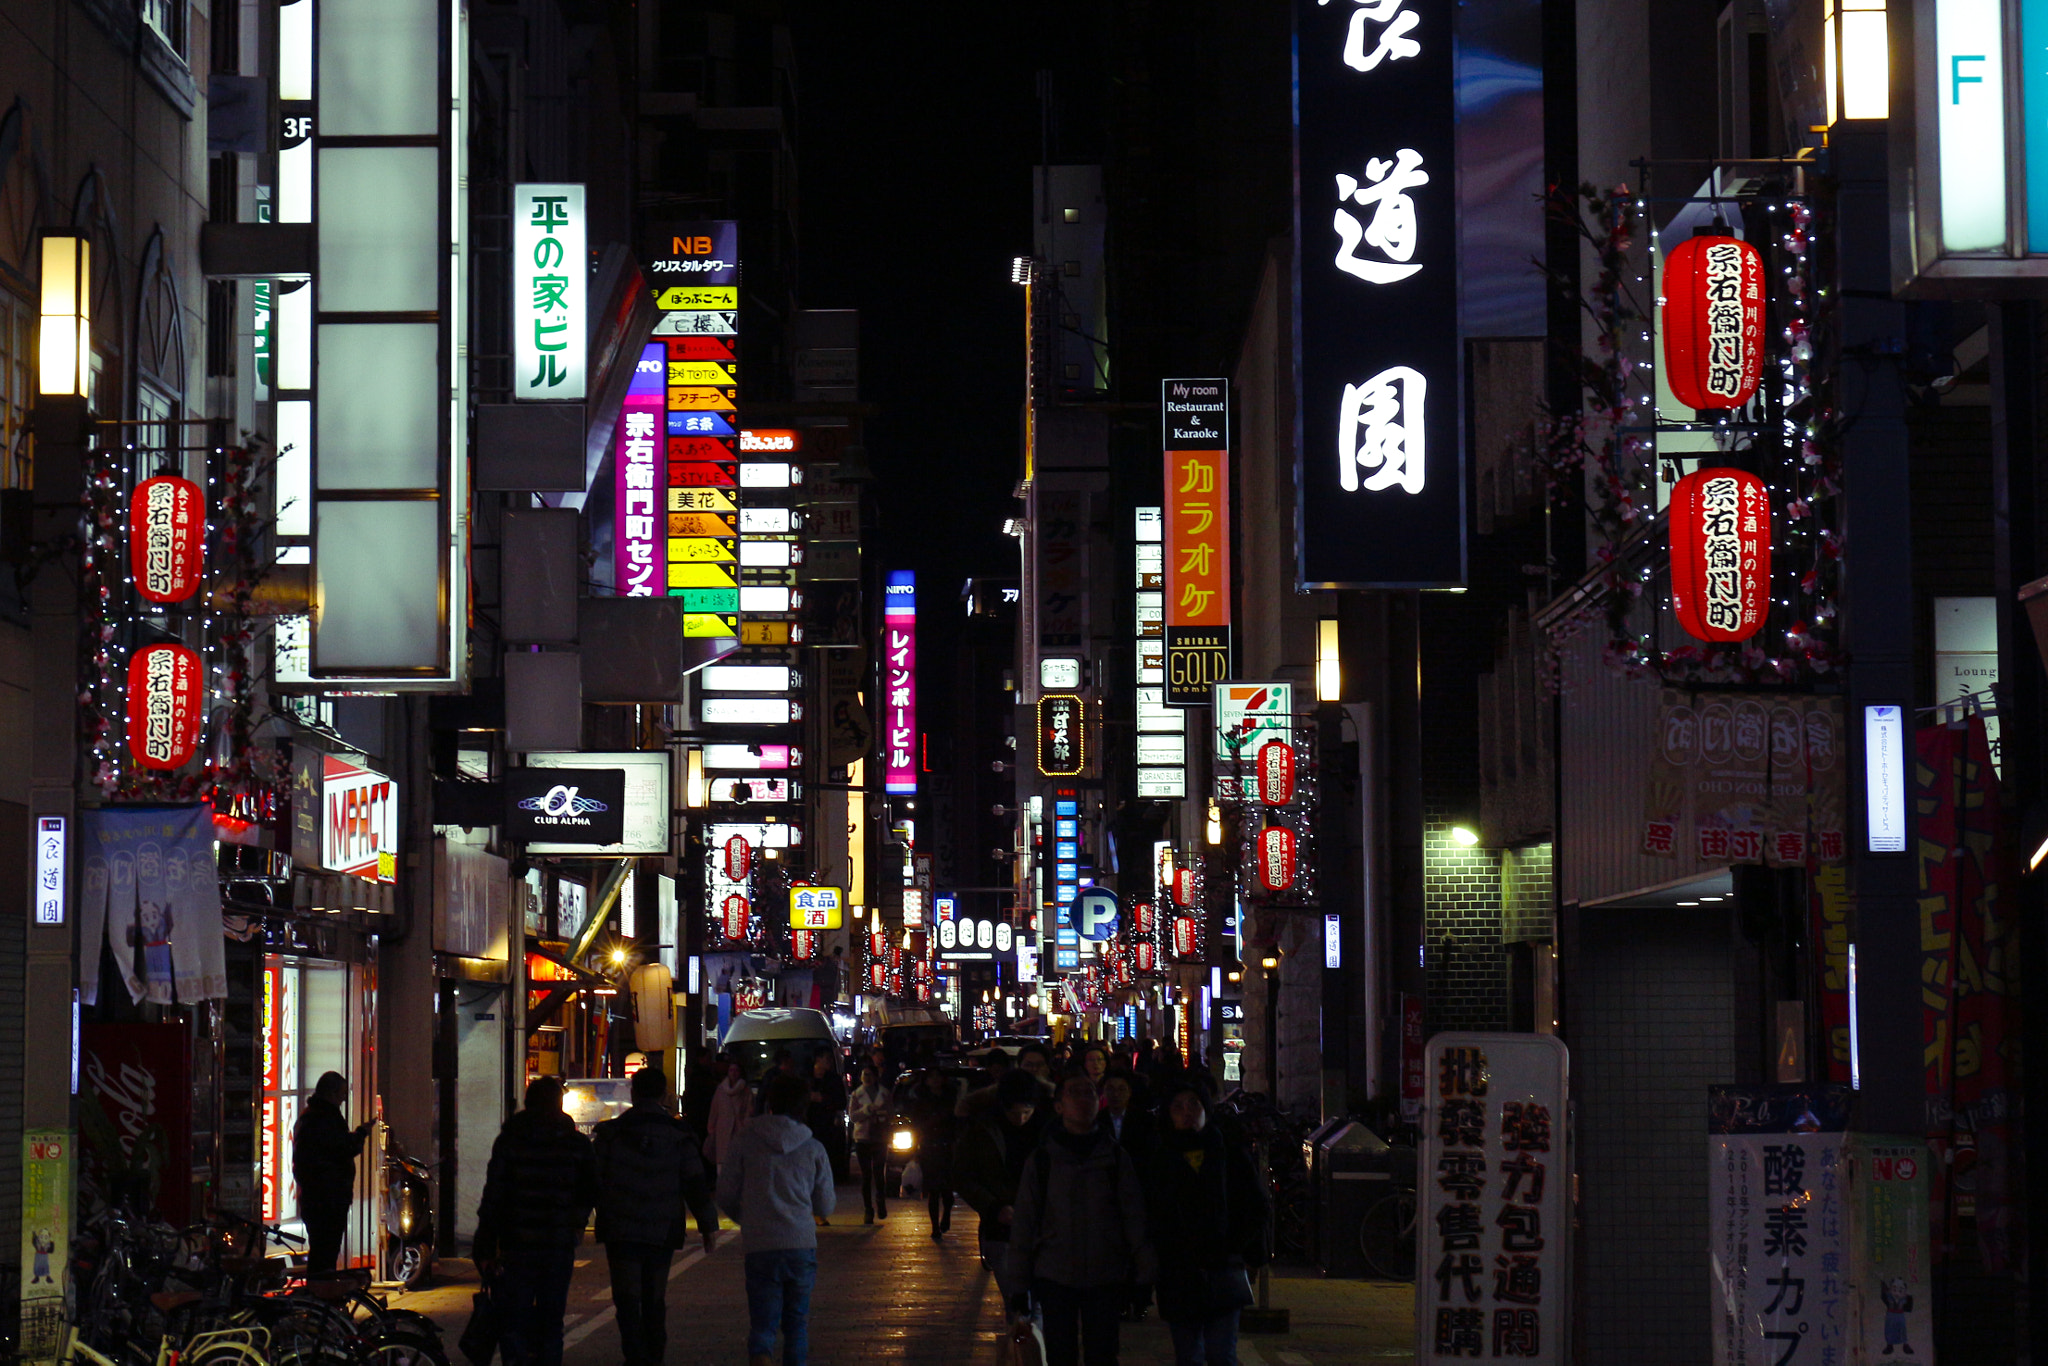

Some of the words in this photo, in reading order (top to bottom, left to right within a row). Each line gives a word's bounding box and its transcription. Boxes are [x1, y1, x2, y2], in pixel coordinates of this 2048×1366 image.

[1952, 55, 1985, 105] F
[284, 117, 312, 138] 3F
[672, 236, 713, 255] NB
[652, 260, 734, 272] クリスタルタワー
[531, 195, 569, 388] 平の家ビル
[726, 313, 735, 325] 7
[1706, 243, 1744, 398] 宗右衛門町
[688, 369, 718, 380] TOTO
[727, 365, 736, 374] 5
[727, 389, 736, 399] 5
[1173, 383, 1189, 398] My
[1192, 384, 1218, 395] room
[1167, 402, 1224, 412] Restaurant
[727, 414, 736, 424] 4
[1190, 415, 1201, 426] &
[1173, 428, 1218, 439] Karaoke
[727, 466, 735, 475] 3
[677, 491, 714, 508] 美花
[728, 491, 736, 501] 3
[791, 511, 803, 529] 6F
[147, 482, 174, 595] 宗右衛門町
[727, 540, 735, 549] 2
[1179, 459, 1215, 617] カラオケ
[791, 545, 803, 563] 5F
[1703, 477, 1744, 633] 宗右衛門町
[729, 567, 735, 576] 1
[791, 589, 803, 608] 4F
[886, 585, 914, 594] NIPPO
[791, 624, 803, 642] 4F
[1177, 637, 1219, 645] SHIDAX
[1170, 652, 1226, 685] GOLD
[791, 670, 803, 688] 3F
[147, 649, 174, 762] 宗右衛門町
[891, 630, 911, 768] レインボービル
[791, 702, 803, 720] 3F
[1224, 710, 1244, 718] SEVEN
[1052, 711, 1070, 761] 甘太郎
[791, 747, 803, 766] 2F
[791, 781, 803, 799] 1F
[329, 781, 390, 867] IMPACT
[534, 816, 558, 825] CLUB
[560, 816, 591, 826] ALPHA
[43, 837, 60, 921] 食道園
[797, 891, 836, 908] 食品
[807, 910, 826, 925] 酒
[1083, 896, 1117, 935] P
